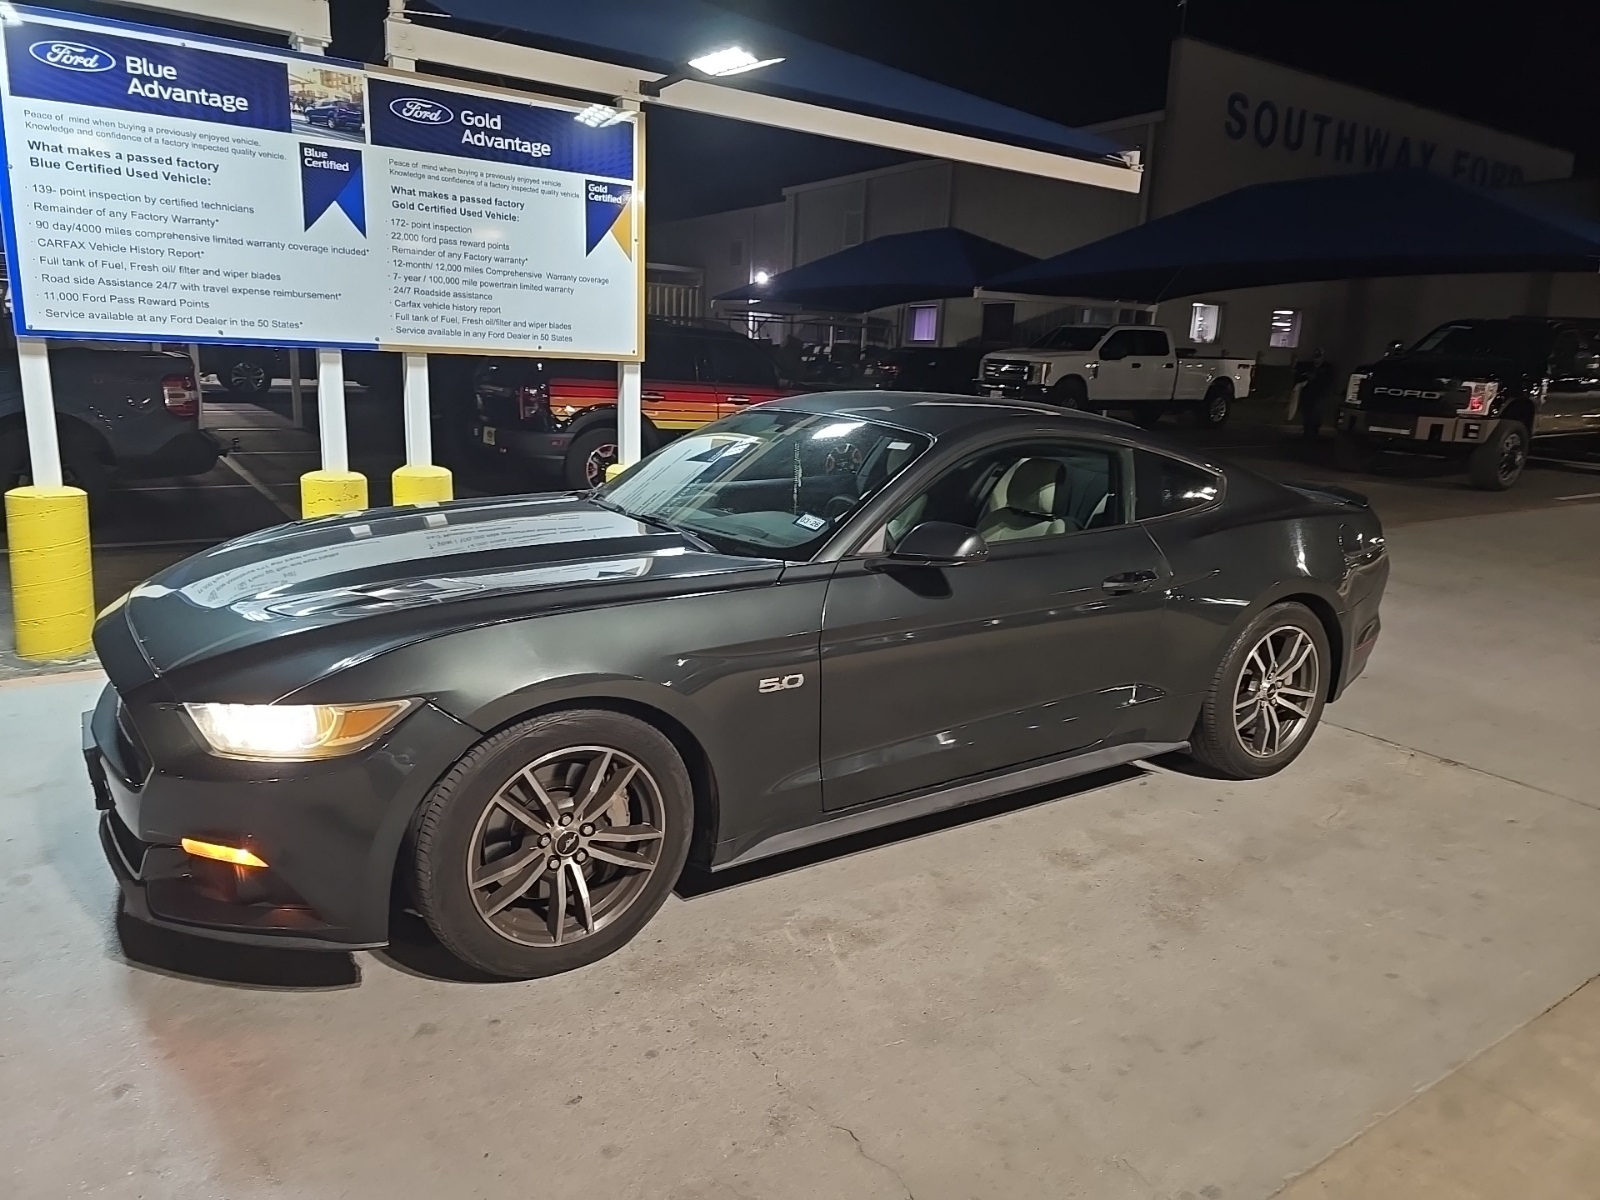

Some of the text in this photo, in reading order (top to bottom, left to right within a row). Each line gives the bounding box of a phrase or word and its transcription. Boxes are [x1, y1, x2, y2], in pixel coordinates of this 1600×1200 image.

[46, 43, 99, 68] Ford
[126, 55, 177, 80] Blue
[127, 77, 248, 112] Advantage
[402, 100, 442, 122] Ford
[460, 110, 501, 130] Gold
[23, 110, 52, 120] Peace
[68, 116, 90, 124] mind
[91, 119, 116, 127] when
[117, 122, 146, 133] buying
[155, 127, 197, 139] previously
[198, 133, 230, 142] enjoyed
[231, 137, 261, 146] vehicle.
[1224, 91, 1437, 169] SOUTHWAY
[24, 121, 74, 134] Knowledge
[76, 128, 93, 136] and
[95, 131, 142, 142] confidence
[161, 137, 189, 149] factory
[191, 142, 229, 153] inspected
[230, 148, 256, 157] quality
[257, 151, 286, 160] vehicle.
[461, 129, 551, 157] Advantage
[27, 139, 63, 153] What
[67, 146, 111, 158] makes
[126, 153, 172, 165] passed
[175, 157, 219, 173] factory
[304, 147, 328, 159] Blue
[29, 156, 211, 185] Blue Certified Used Vehicle:
[304, 158, 349, 172] Certified
[390, 185, 416, 196] What
[418, 190, 449, 200] makes
[459, 195, 492, 205] passed
[494, 197, 524, 211] factory
[588, 184, 608, 193] Gold
[588, 192, 622, 203] Certified
[59, 187, 86, 197] point
[88, 189, 141, 202] inspection
[143, 194, 156, 205] by
[159, 198, 198, 208] certified
[200, 201, 254, 213] technicians
[33, 201, 93, 215] Remainder
[95, 207, 106, 216] of
[108, 210, 127, 220] any
[130, 210, 168, 223] Factory
[391, 200, 519, 221] Gold Certified Used Vehicle:
[35, 220, 49, 229] 90
[52, 221, 101, 233] day/4000
[104, 226, 132, 236] miles
[134, 230, 210, 242] comprehensive
[212, 235, 243, 245] limited
[245, 240, 285, 250] warranty
[287, 243, 328, 254] coverage
[411, 221, 431, 229] point
[432, 222, 472, 233] inspection
[37, 238, 86, 249] CARFAX
[88, 241, 126, 252] Vehicle
[129, 244, 165, 257] History
[421, 234, 436, 243] ford
[459, 240, 485, 248] reward
[487, 242, 509, 250] points
[391, 245, 436, 256] Remainder
[447, 252, 462, 260] any
[463, 251, 492, 263] Factory
[39, 255, 59, 265] Full
[61, 257, 85, 267] tank
[87, 259, 98, 267] of
[129, 261, 159, 272] Fresh
[178, 265, 200, 274] filter
[202, 268, 220, 276] and
[222, 269, 248, 279] wiper
[250, 271, 281, 280] blades
[463, 266, 484, 274] miles
[485, 266, 542, 278] Comprehensive
[545, 272, 577, 283] Warranty
[578, 276, 609, 285] coverage
[41, 273, 70, 283] Road
[73, 275, 95, 284] side
[97, 277, 153, 288] Assistance
[155, 280, 177, 289] 24/7
[179, 282, 200, 291] with
[202, 284, 228, 293] travel
[231, 287, 270, 295] expense
[393, 285, 492, 300] 24/7 Roadside assistance
[461, 278, 477, 286] mile
[479, 280, 518, 288] powertrain
[519, 282, 543, 291] limited
[544, 286, 574, 295] warranty
[82, 293, 106, 302] Ford
[109, 294, 135, 304] Pass
[137, 296, 177, 306] Reward
[179, 298, 209, 308] Points
[394, 299, 421, 308] Carfax
[422, 302, 450, 310] vehicle
[451, 303, 477, 313] history
[45, 308, 85, 318] Service
[88, 311, 134, 321] available
[149, 315, 167, 324] any
[169, 314, 192, 323] Ford
[195, 316, 228, 325] Dealer
[229, 317, 237, 325] in
[240, 318, 255, 326] the
[257, 319, 269, 327] 50
[395, 325, 425, 334] Service
[427, 328, 461, 336] available
[471, 331, 486, 339] any
[487, 330, 504, 338] Ford
[506, 331, 530, 339] Dealer
[540, 333, 549, 341] 50
[550, 334, 573, 342] States
[1373, 387, 1441, 399] FORD
